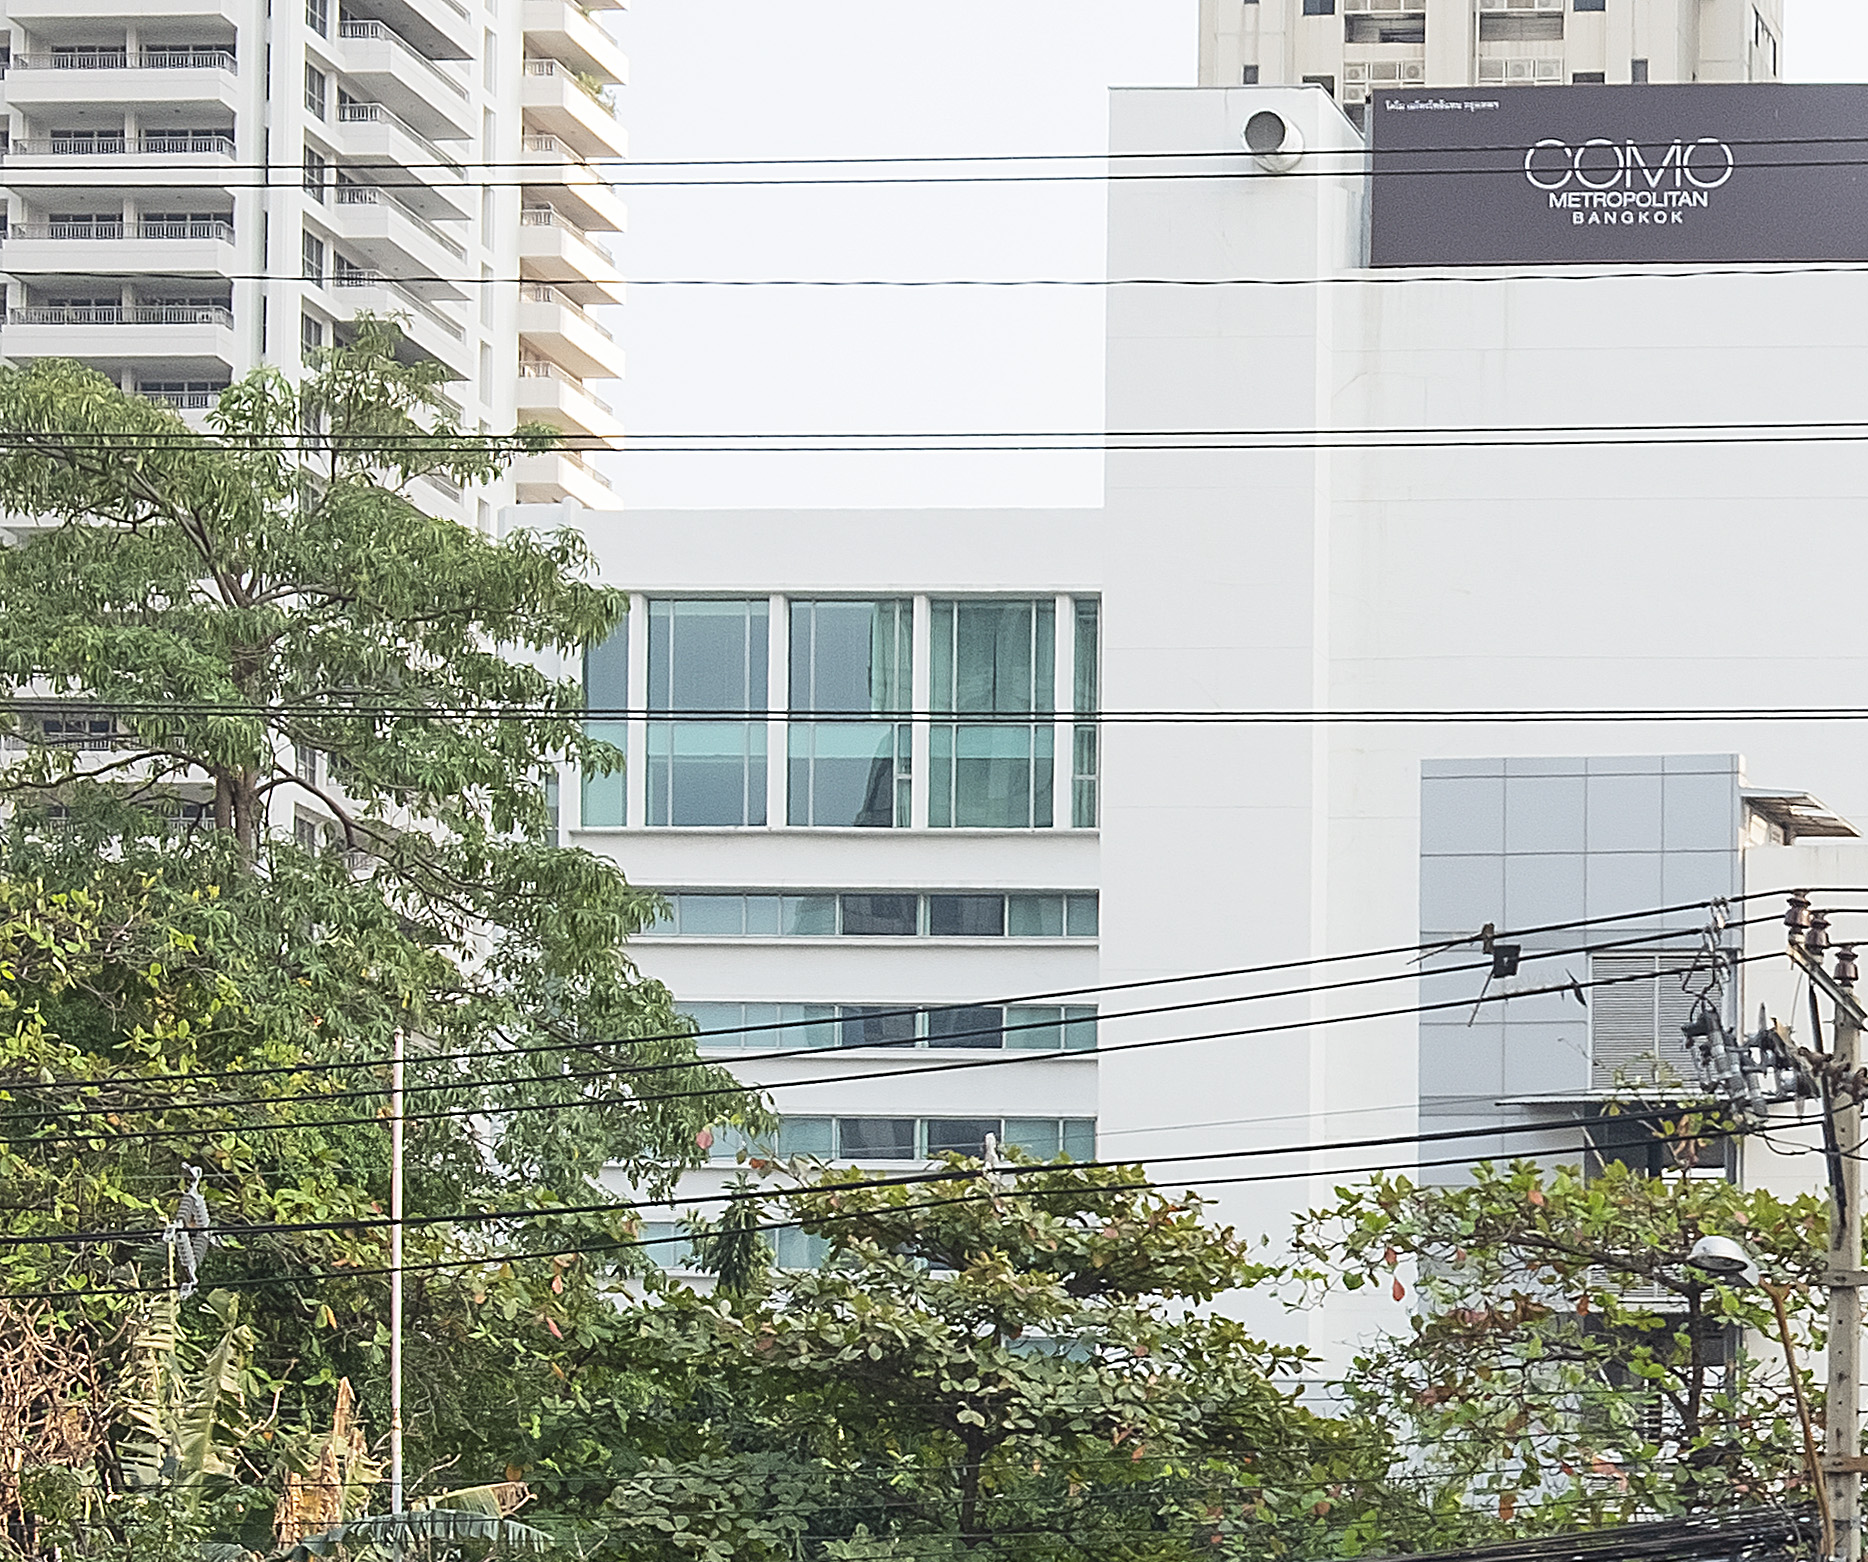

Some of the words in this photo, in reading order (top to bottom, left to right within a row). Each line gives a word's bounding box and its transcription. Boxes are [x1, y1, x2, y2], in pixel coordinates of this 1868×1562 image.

[1524, 137, 1734, 189] COMO
[1549, 191, 1709, 208] METROPOLITAN
[1572, 210, 1684, 225] BANGKOK
